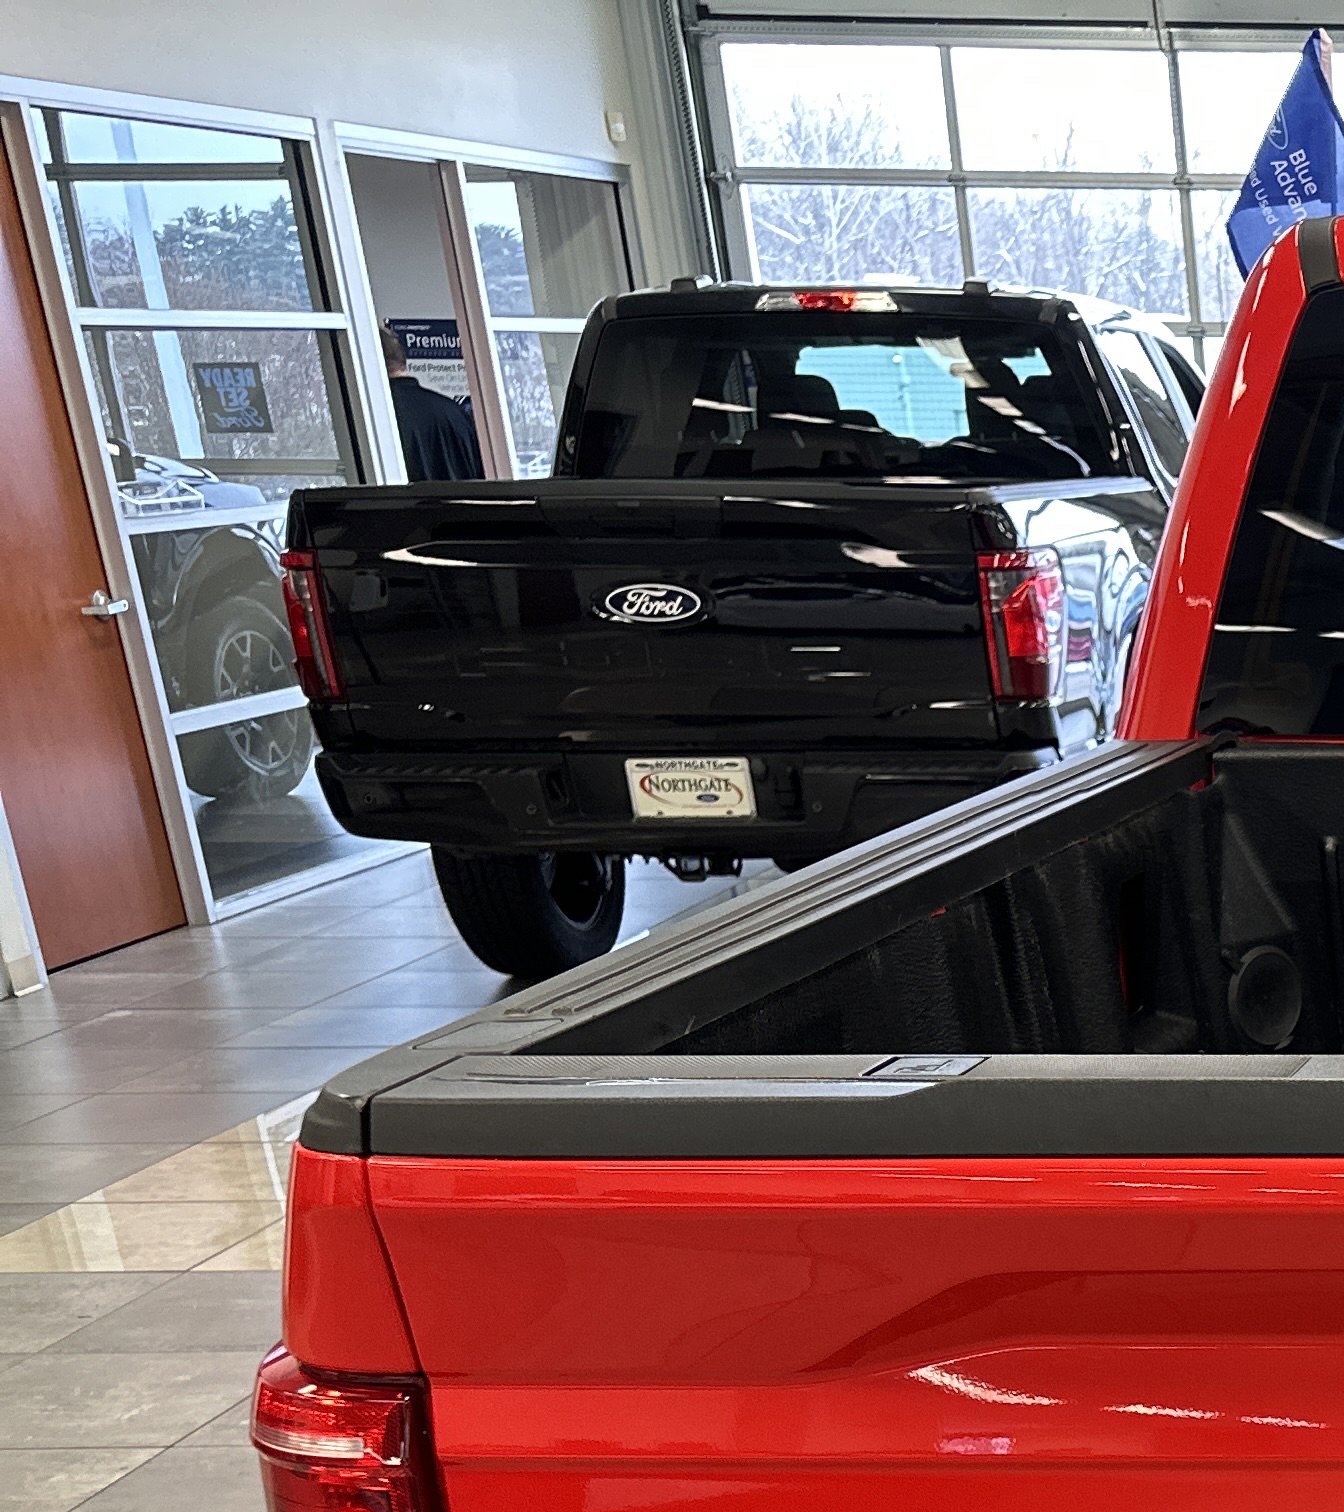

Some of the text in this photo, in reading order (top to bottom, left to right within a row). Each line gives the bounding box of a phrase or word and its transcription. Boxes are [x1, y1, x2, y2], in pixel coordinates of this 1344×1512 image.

[1288, 148, 1318, 196] Blue
[1255, 187, 1280, 225] Used
[622, 588, 684, 617] Ford
[648, 775, 732, 793] NORTHGATE
